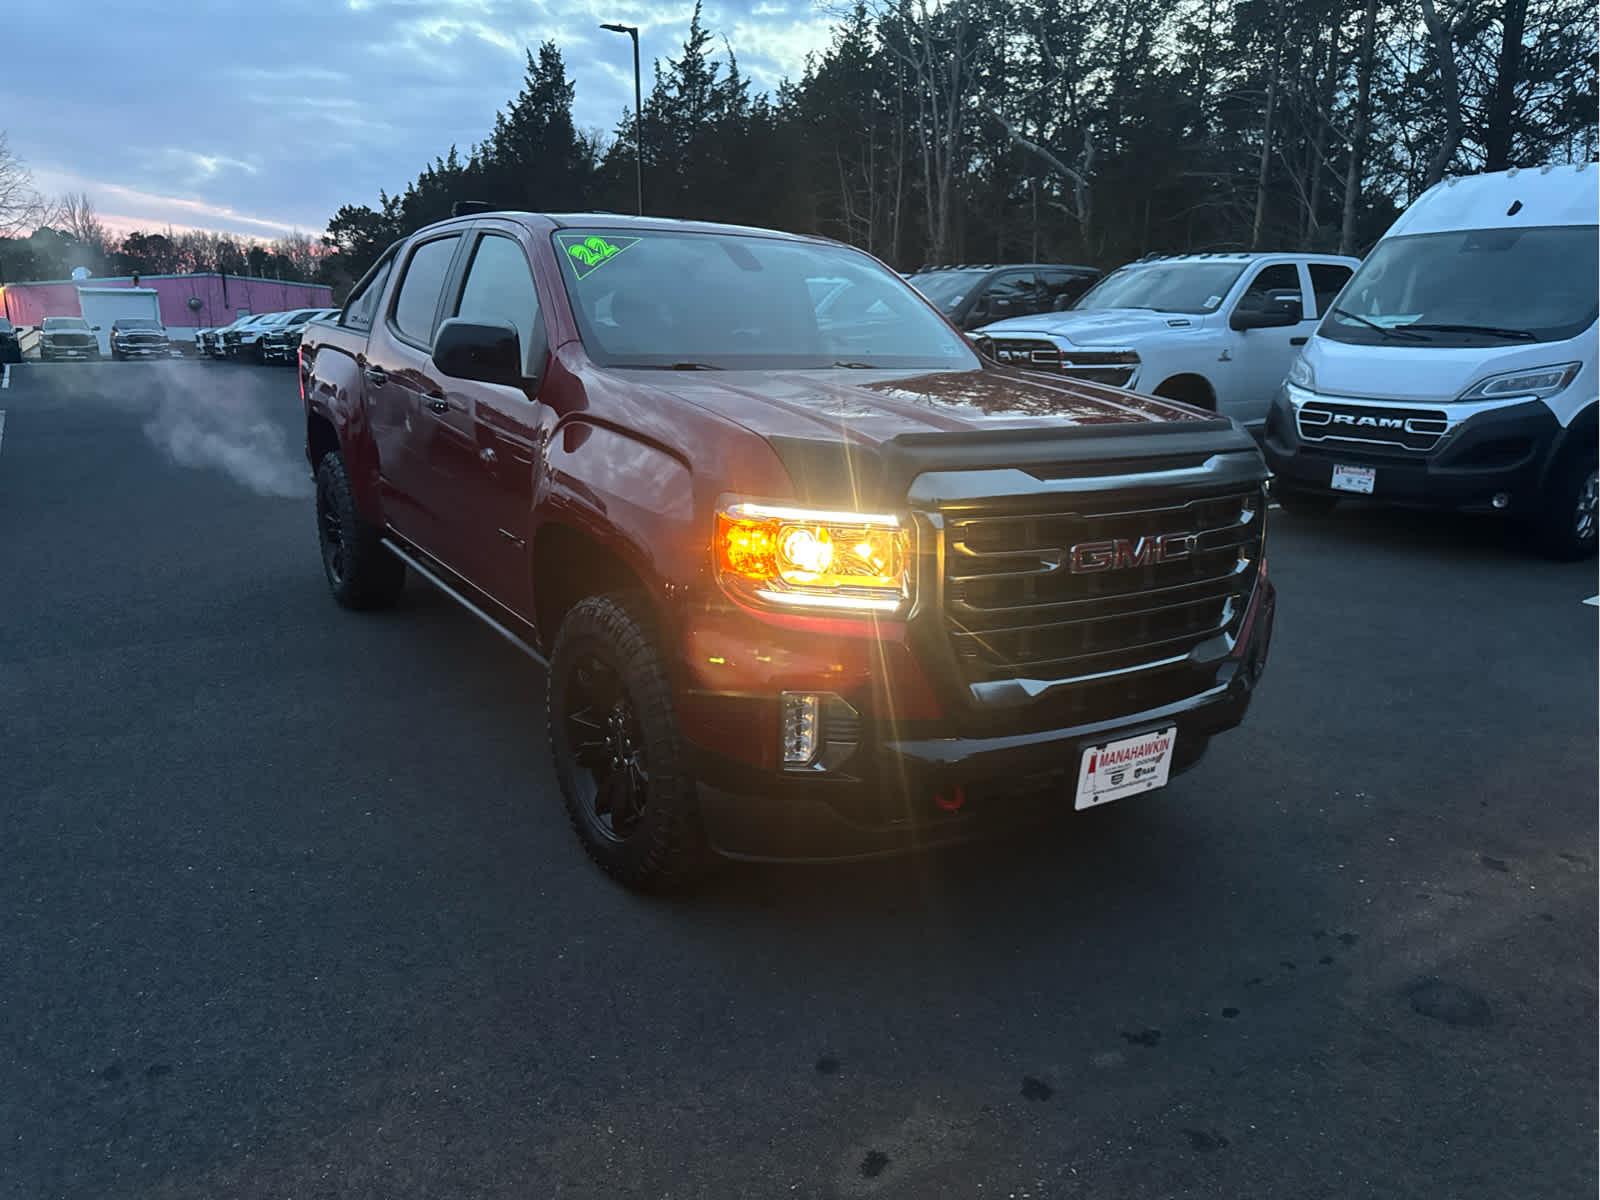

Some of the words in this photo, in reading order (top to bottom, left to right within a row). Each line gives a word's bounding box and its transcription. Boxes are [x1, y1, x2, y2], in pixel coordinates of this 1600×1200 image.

[568, 236, 620, 266] 22
[1333, 414, 1403, 428] RAM
[1071, 531, 1191, 574] GMC
[1099, 738, 1170, 768] MANAHAWKIN
